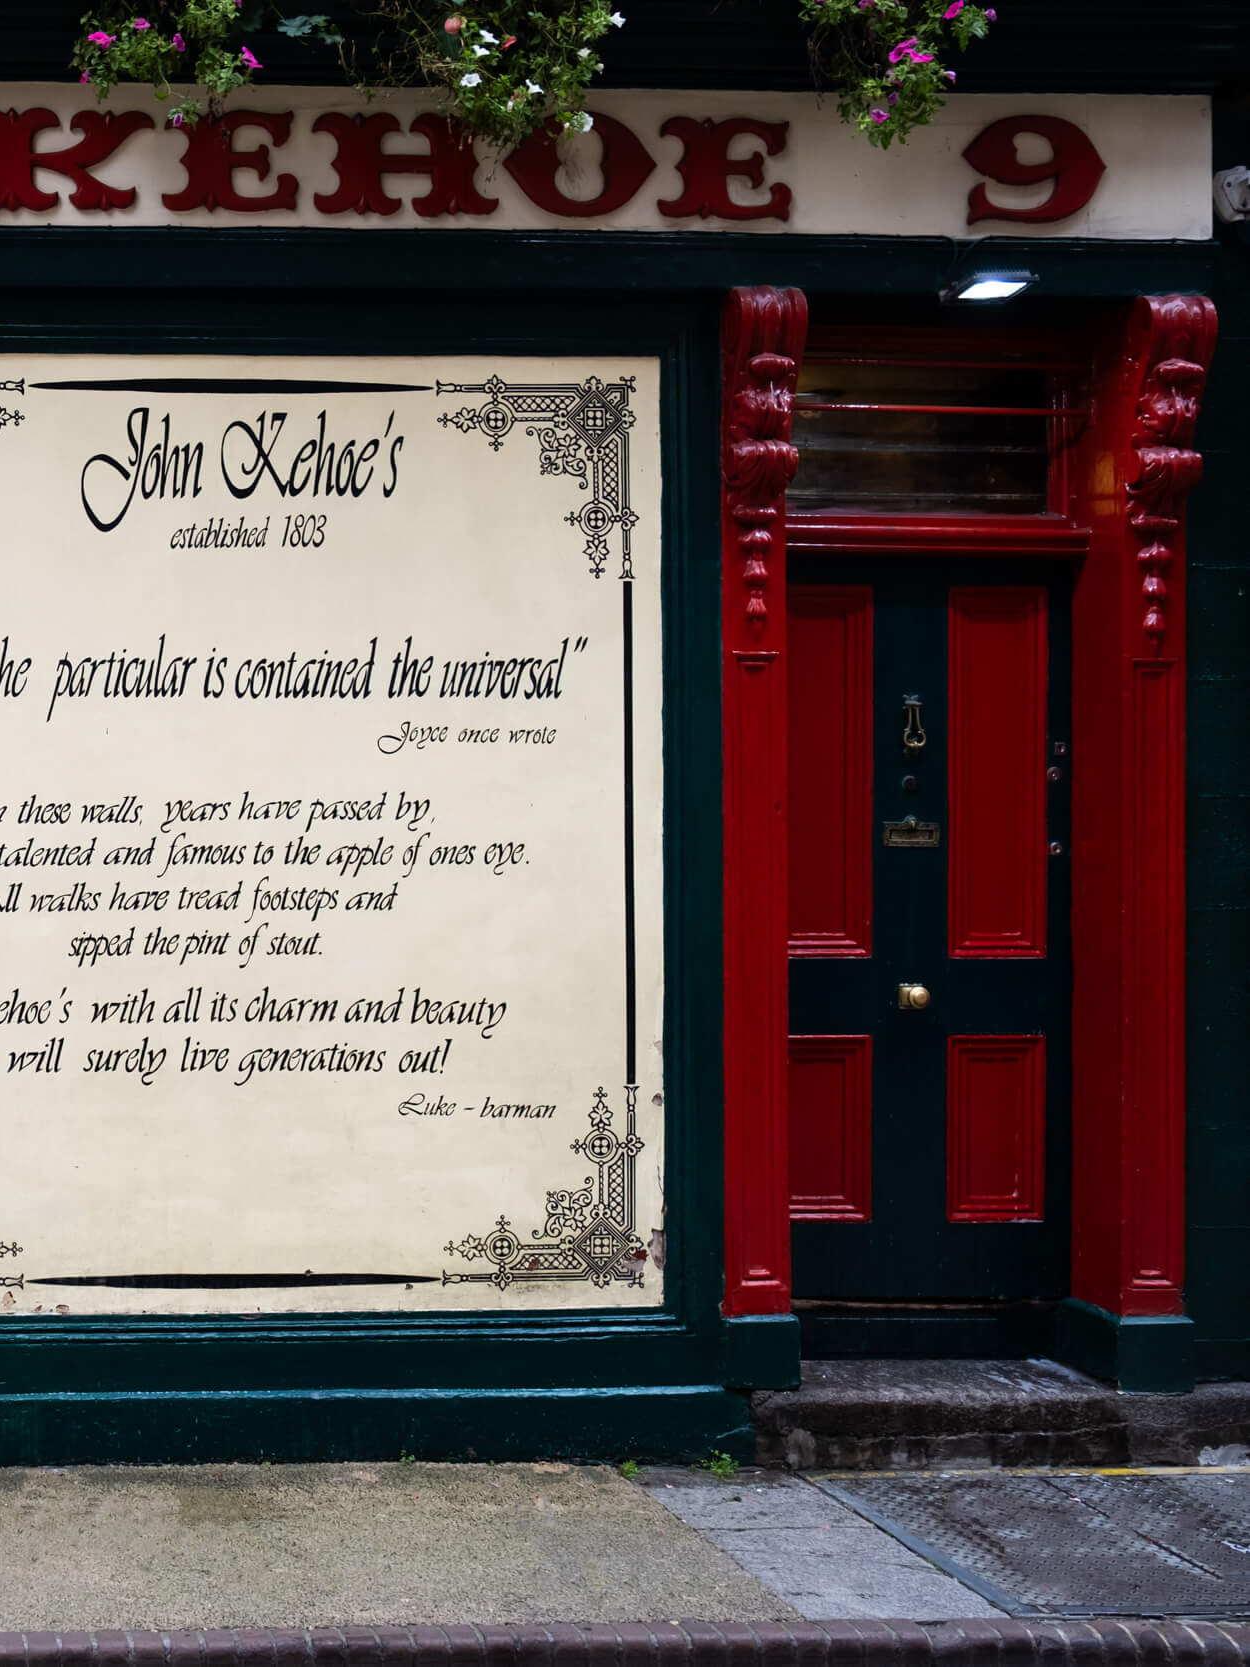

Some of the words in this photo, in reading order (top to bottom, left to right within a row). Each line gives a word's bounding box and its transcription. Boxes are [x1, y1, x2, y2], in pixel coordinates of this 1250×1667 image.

[961, 114, 1107, 226] 9
[80, 406, 204, 533] John
[220, 409, 405, 499] Kehoe's
[170, 515, 271, 550] established
[281, 513, 328, 548] 1803
[46, 633, 198, 723] particular
[203, 647, 228, 699] is
[234, 636, 378, 700] contained
[387, 635, 434, 699] the
[377, 721, 449, 755] Joyce
[457, 728, 500, 744] once
[509, 727, 557, 745] wrote
[17, 794, 72, 825] these
[80, 795, 143, 824] walls,
[160, 799, 232, 834] years
[238, 791, 302, 820] have
[304, 791, 388, 833] passed
[395, 791, 436, 832] by,
[102, 836, 157, 866] and
[156, 832, 247, 879] famous
[253, 841, 275, 865] to
[284, 835, 322, 866] the
[325, 836, 395, 878] apple
[401, 831, 431, 879] of
[429, 844, 477, 866] ones
[484, 841, 530, 876] eye.
[29, 881, 102, 913] walks
[108, 881, 170, 912] have
[177, 880, 243, 911] tread
[244, 875, 340, 924] footsteps
[345, 881, 399, 911] and
[67, 926, 136, 968] sipped
[143, 926, 180, 956] the
[179, 929, 231, 966] pint
[238, 922, 269, 969] of
[266, 932, 323, 956] stout.
[90, 988, 156, 1024] with
[162, 986, 203, 1024] all
[210, 991, 239, 1023] its
[244, 986, 339, 1023] charm
[344, 987, 406, 1024] and
[410, 987, 507, 1040] beauty
[7, 1037, 65, 1073] will
[82, 1036, 167, 1086] surely
[180, 1036, 230, 1073] live
[233, 1042, 387, 1087] generations
[398, 1038, 453, 1075] out!
[398, 1093, 457, 1116] Luke
[479, 1096, 557, 1119] barman
